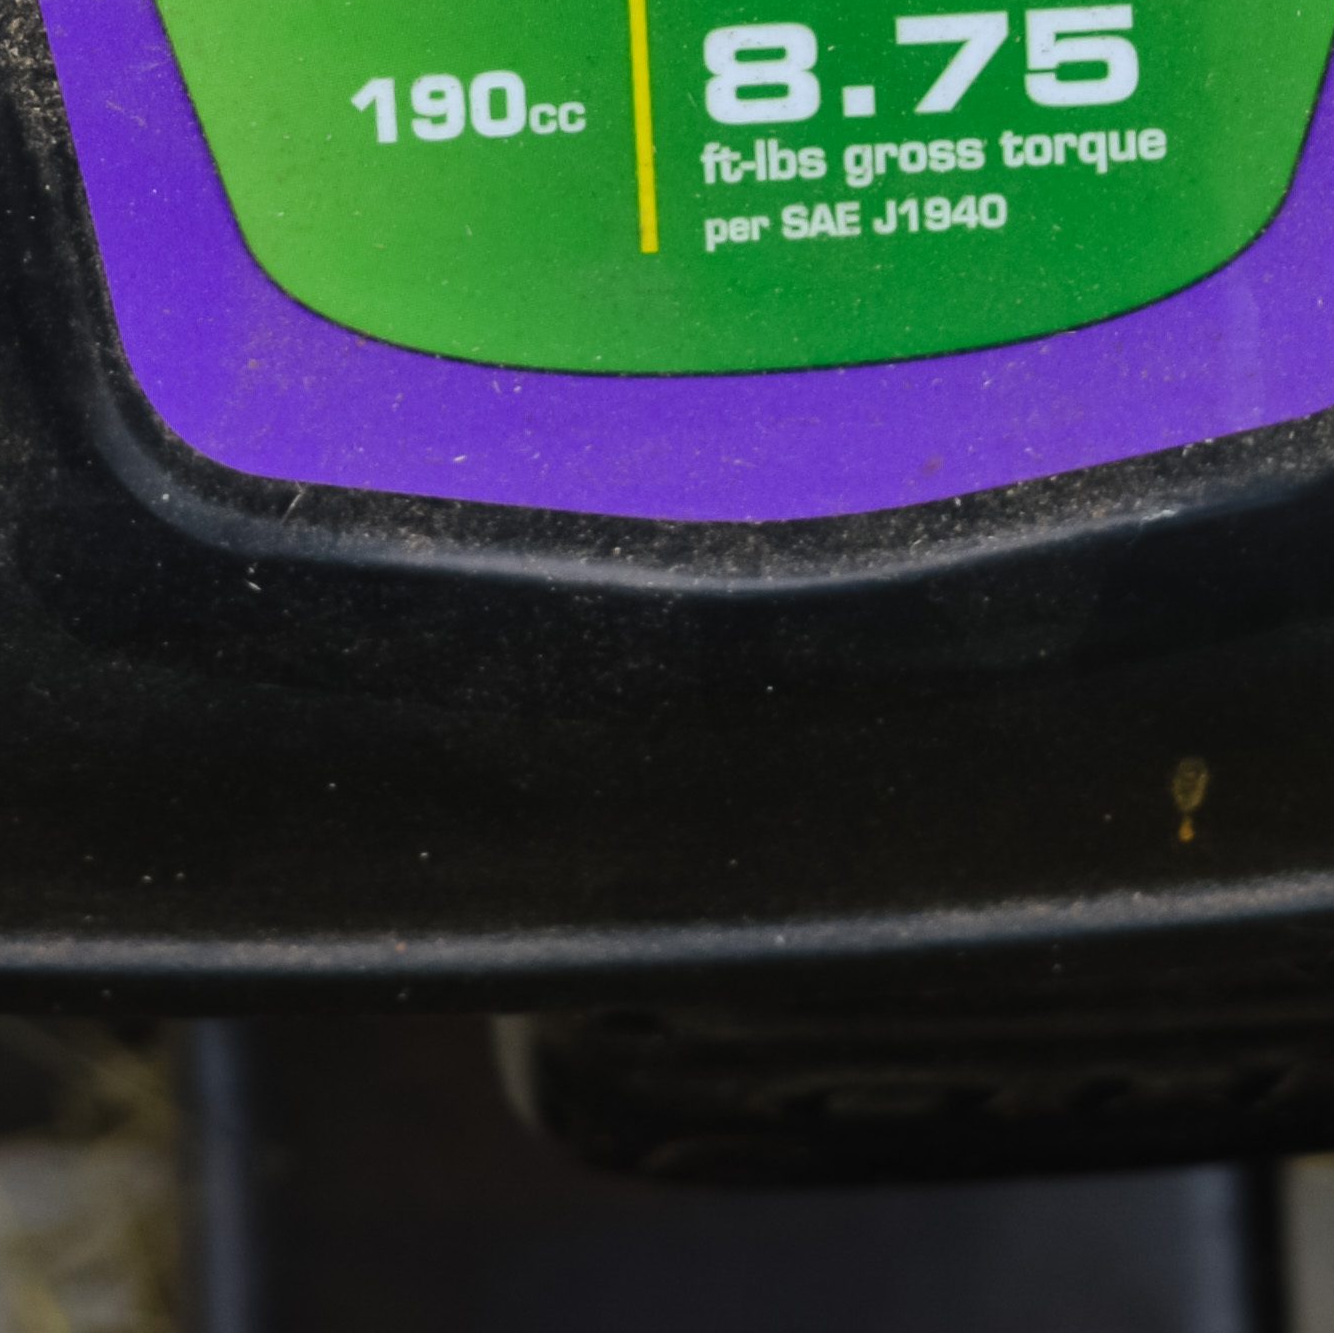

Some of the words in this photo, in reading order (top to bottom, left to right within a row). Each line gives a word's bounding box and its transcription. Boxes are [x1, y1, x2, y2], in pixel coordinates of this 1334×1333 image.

[702, 2, 1141, 126] 8.75
[349, 69, 588, 146] 190cc
[700, 138, 828, 185] ft-lbs
[842, 136, 986, 189] gross
[1000, 126, 1169, 175] torque
[704, 212, 771, 253] per
[780, 200, 862, 241] SAE
[873, 193, 1009, 234] J1940
